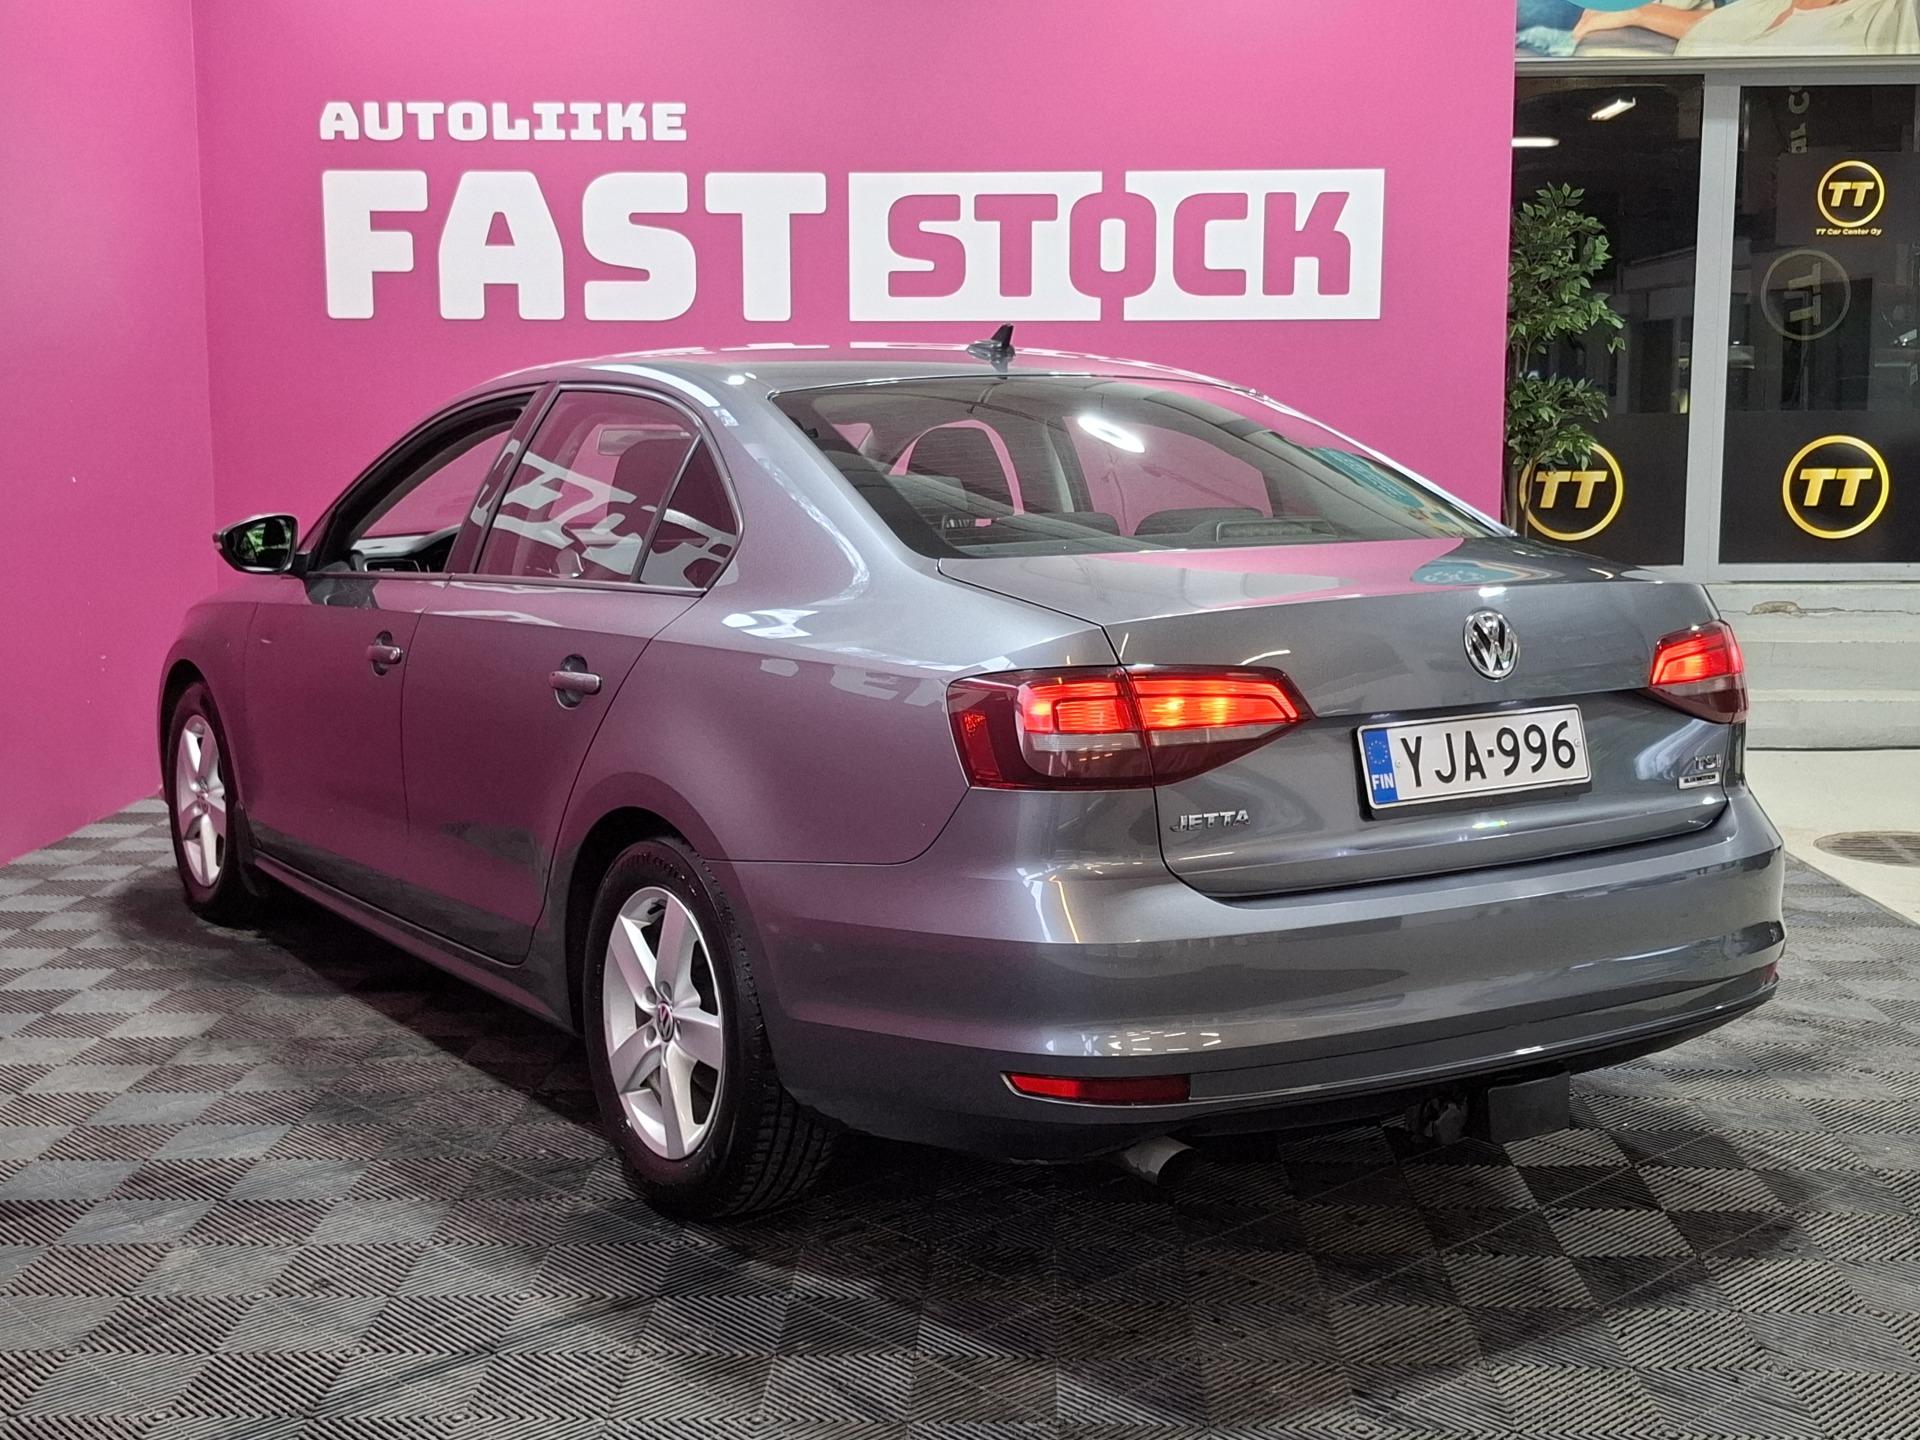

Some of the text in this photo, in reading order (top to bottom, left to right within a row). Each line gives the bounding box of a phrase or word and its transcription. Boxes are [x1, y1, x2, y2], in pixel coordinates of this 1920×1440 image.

[320, 102, 687, 141] AUTOLIIKE
[1828, 182, 1875, 207] TT
[322, 170, 1352, 322] FAST STOCK
[1535, 471, 1607, 509] TT
[1800, 468, 1873, 507] TT
[1400, 720, 1577, 788] YJA-996
[1371, 772, 1395, 791] FIN
[1169, 809, 1251, 832] JETTA
